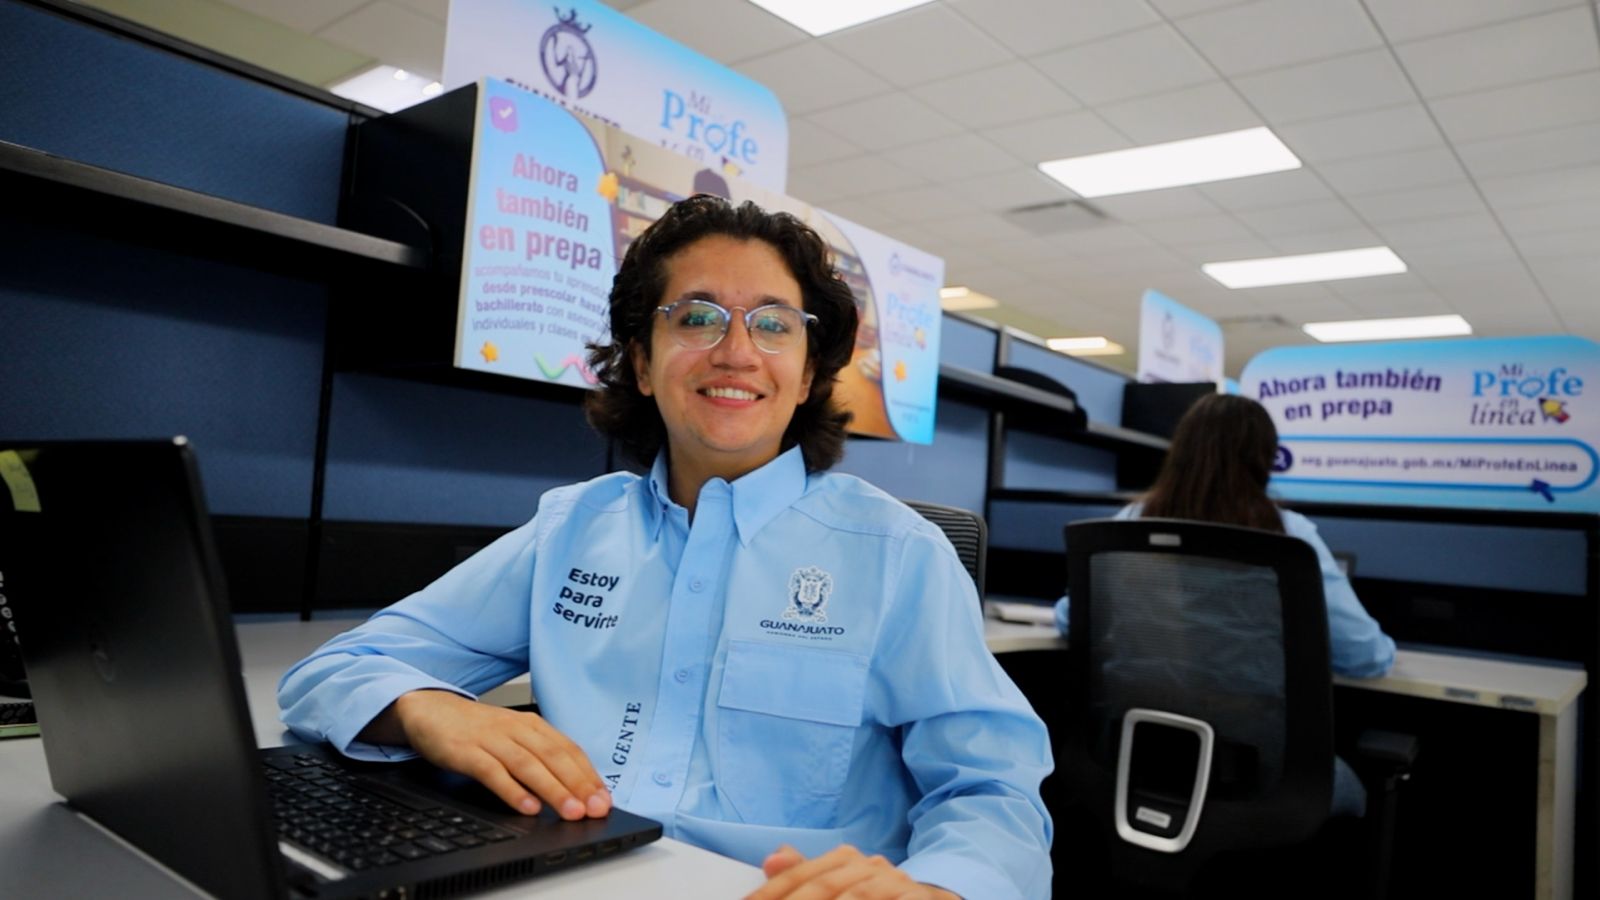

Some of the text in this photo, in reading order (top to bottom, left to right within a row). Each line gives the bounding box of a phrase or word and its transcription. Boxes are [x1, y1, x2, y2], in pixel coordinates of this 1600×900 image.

[660, 88, 758, 165] Profe
[512, 153, 579, 193] Ahora
[496, 187, 589, 232] también
[479, 224, 603, 270] en prepa
[475, 299, 543, 313] bachillerato
[546, 304, 564, 317] con
[482, 281, 605, 316] desde preescolar hast
[472, 316, 536, 331] individuales
[547, 321, 578, 340] clases
[1259, 368, 1442, 399] Ahora también
[1472, 367, 1583, 399] Profe
[1500, 363, 1522, 377] Mi
[1284, 399, 1393, 420] en prepa
[1470, 402, 1536, 425] línea
[568, 567, 620, 592] Estoy
[559, 586, 603, 608] para
[760, 619, 845, 635] GUANAJUATO
[611, 702, 641, 766] GENTE
